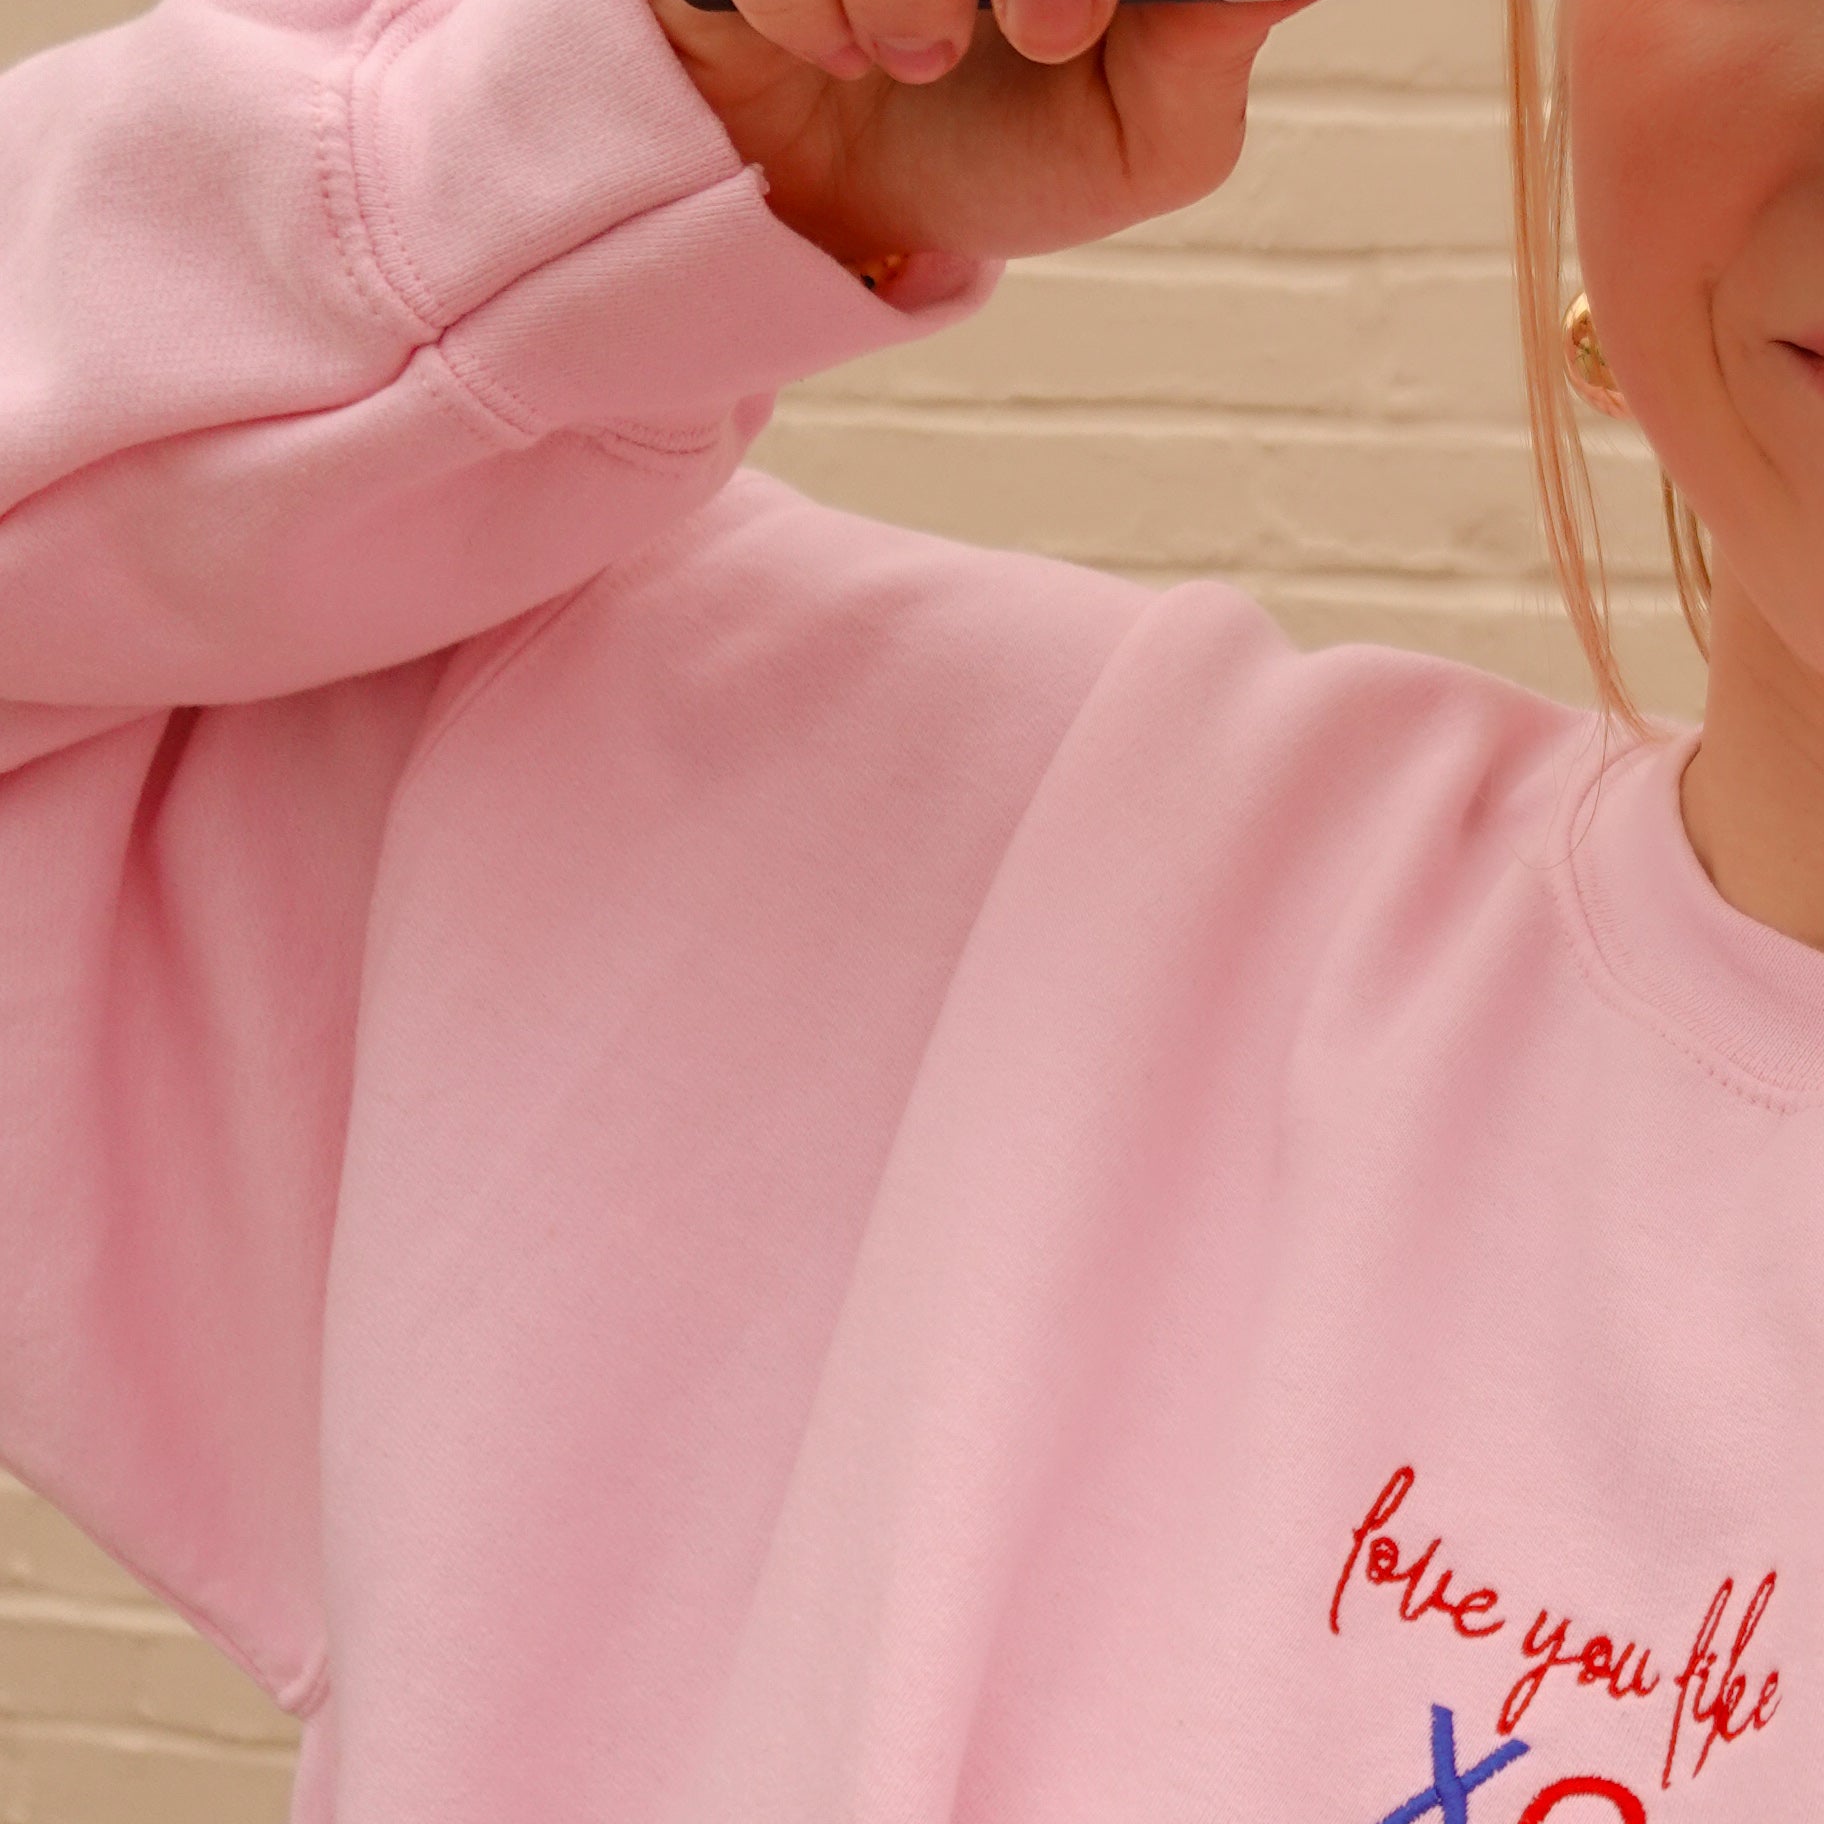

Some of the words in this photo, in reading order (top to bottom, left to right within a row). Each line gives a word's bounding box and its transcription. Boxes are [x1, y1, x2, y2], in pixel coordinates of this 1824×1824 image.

[1328, 1463, 1506, 1638] love
[1495, 1608, 1661, 1737] you
[1660, 1569, 1782, 1791] like
